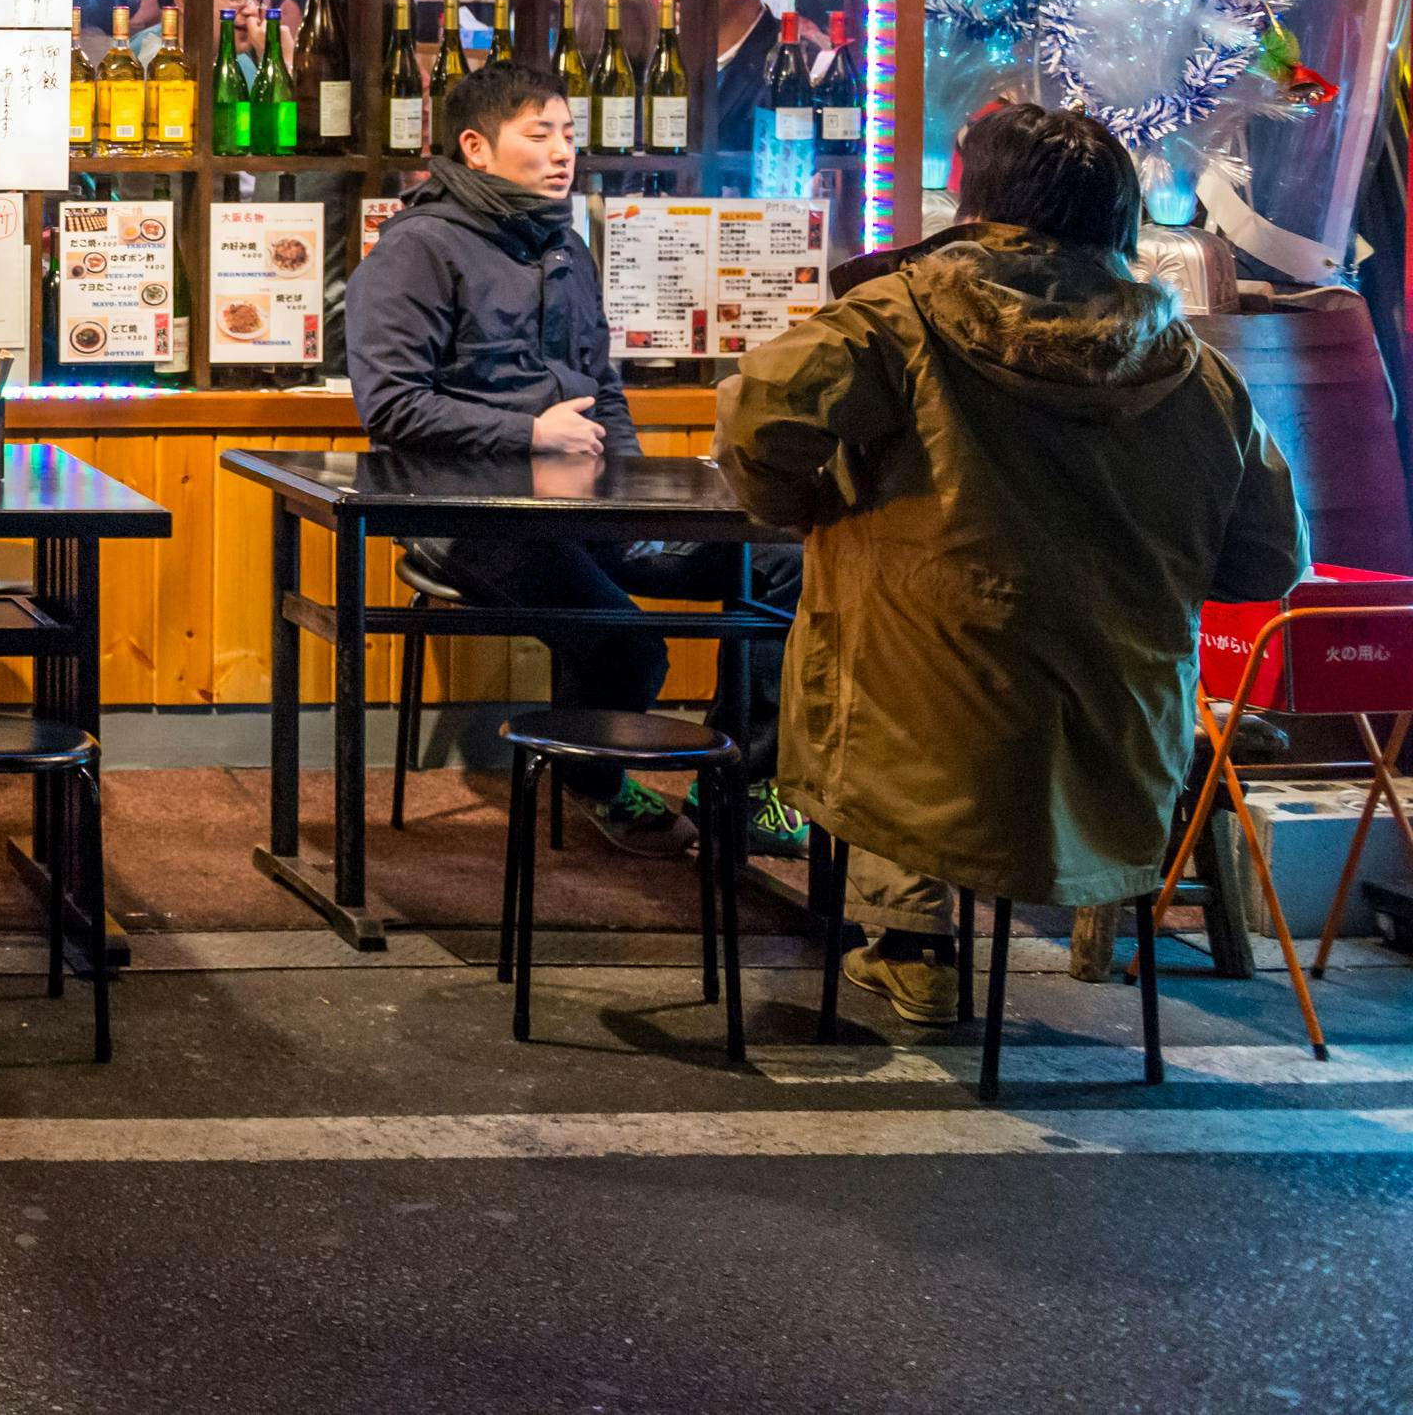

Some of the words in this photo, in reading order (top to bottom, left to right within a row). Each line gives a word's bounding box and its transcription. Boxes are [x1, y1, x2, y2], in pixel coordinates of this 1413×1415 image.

[221, 213, 264, 224] 大阪名物
[70, 239, 96, 248] たこ焼
[221, 242, 257, 251] お好み焼
[1325, 645, 1391, 662] 火の用心
